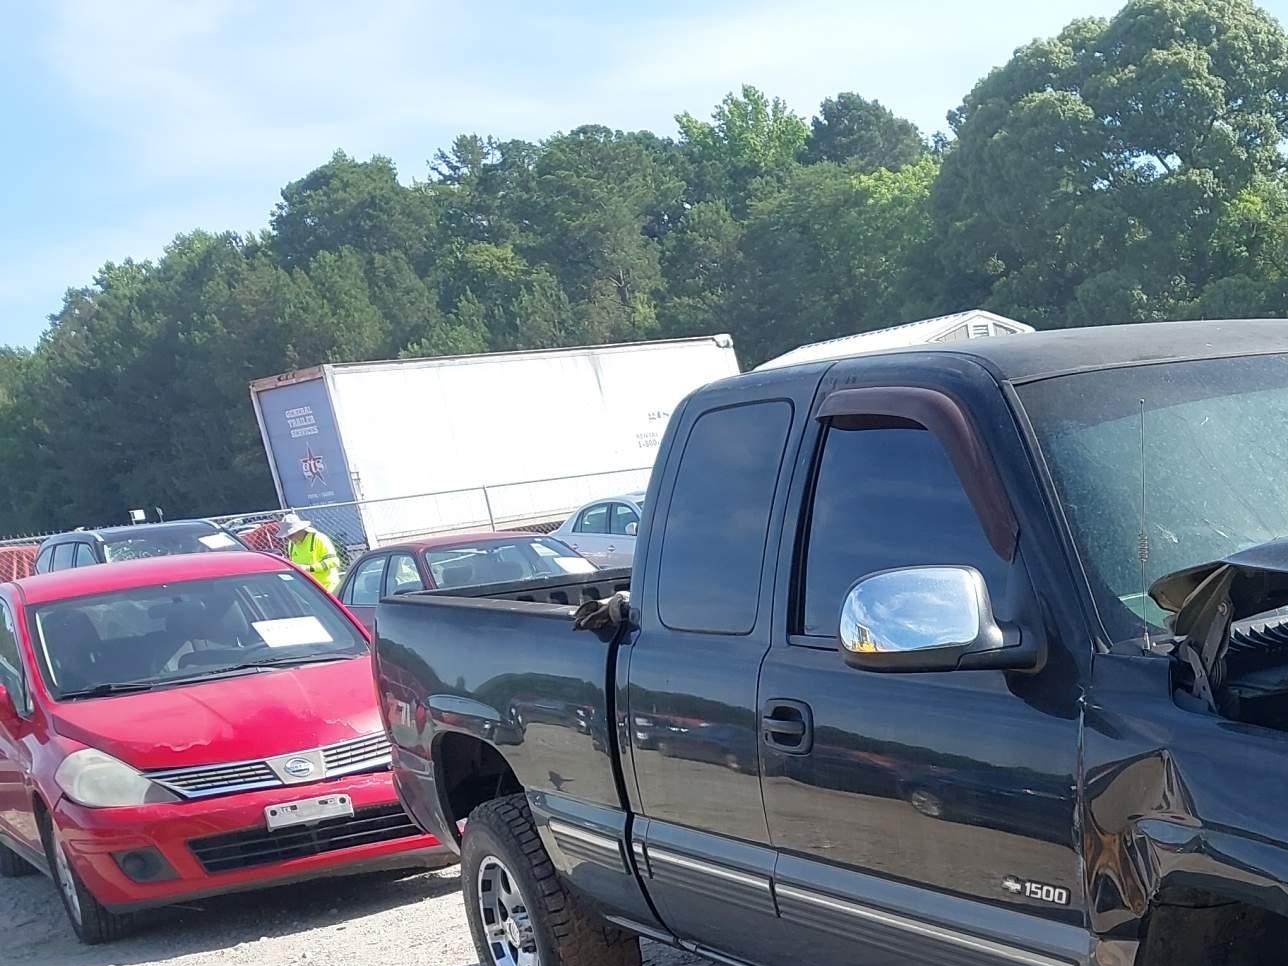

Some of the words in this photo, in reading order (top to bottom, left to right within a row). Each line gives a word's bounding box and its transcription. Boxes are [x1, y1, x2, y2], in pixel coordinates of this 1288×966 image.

[285, 406, 313, 418] GENERAL
[287, 415, 316, 428] TRAILER
[290, 426, 318, 438] SERVICES
[1024, 882, 1067, 905] 1500
